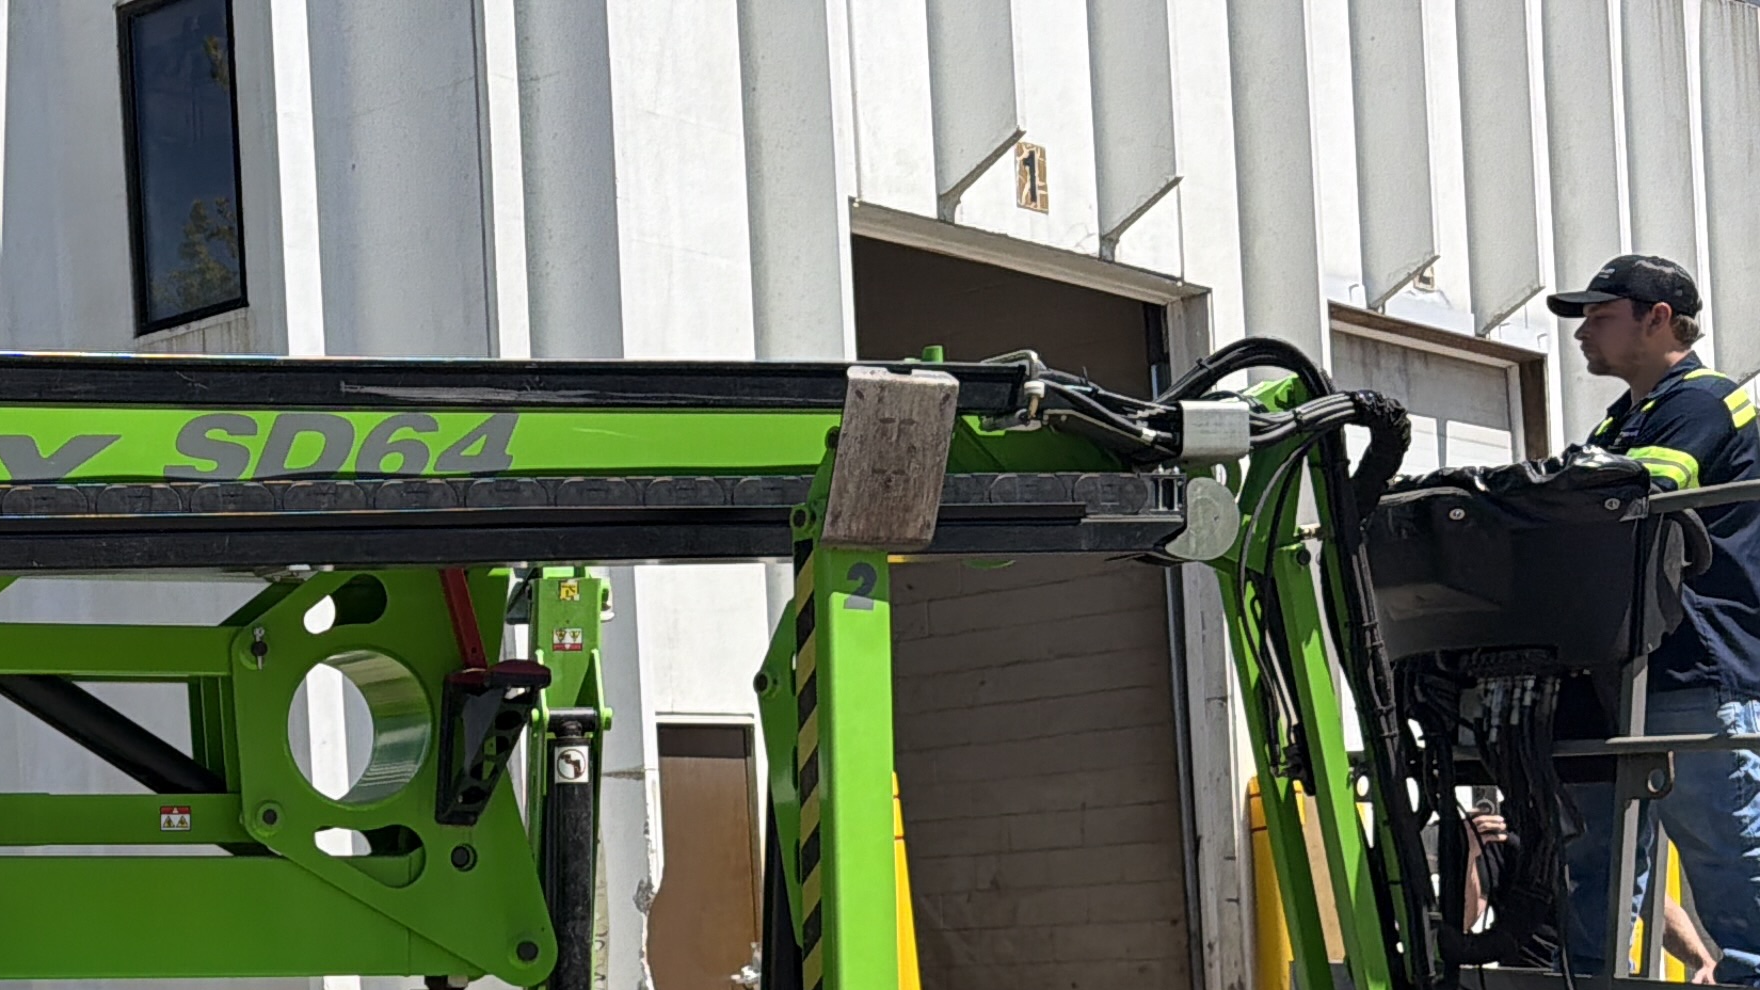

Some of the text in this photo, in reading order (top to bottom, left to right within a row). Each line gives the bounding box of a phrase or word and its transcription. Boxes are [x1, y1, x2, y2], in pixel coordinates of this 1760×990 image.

[1022, 149, 1038, 203] 1
[162, 412, 520, 480] SD64
[844, 562, 877, 610] 2
